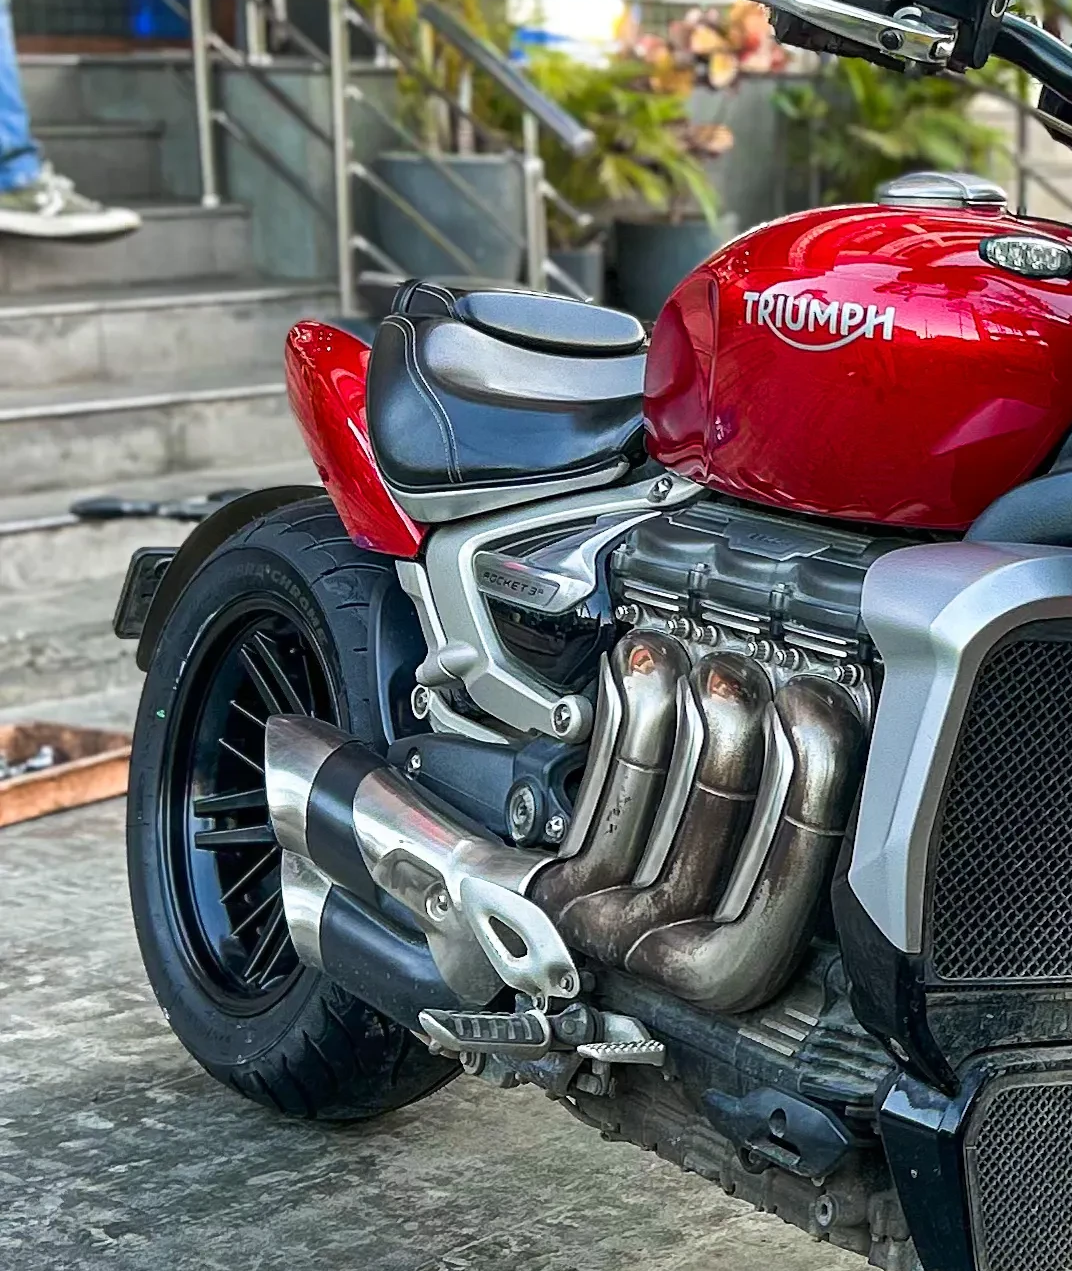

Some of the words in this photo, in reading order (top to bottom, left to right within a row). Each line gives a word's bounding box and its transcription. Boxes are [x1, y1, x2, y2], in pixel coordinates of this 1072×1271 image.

[743, 290, 896, 351] TRIUMPH
[270, 569, 329, 645] CHROME
[482, 571, 528, 592] ROCKET
